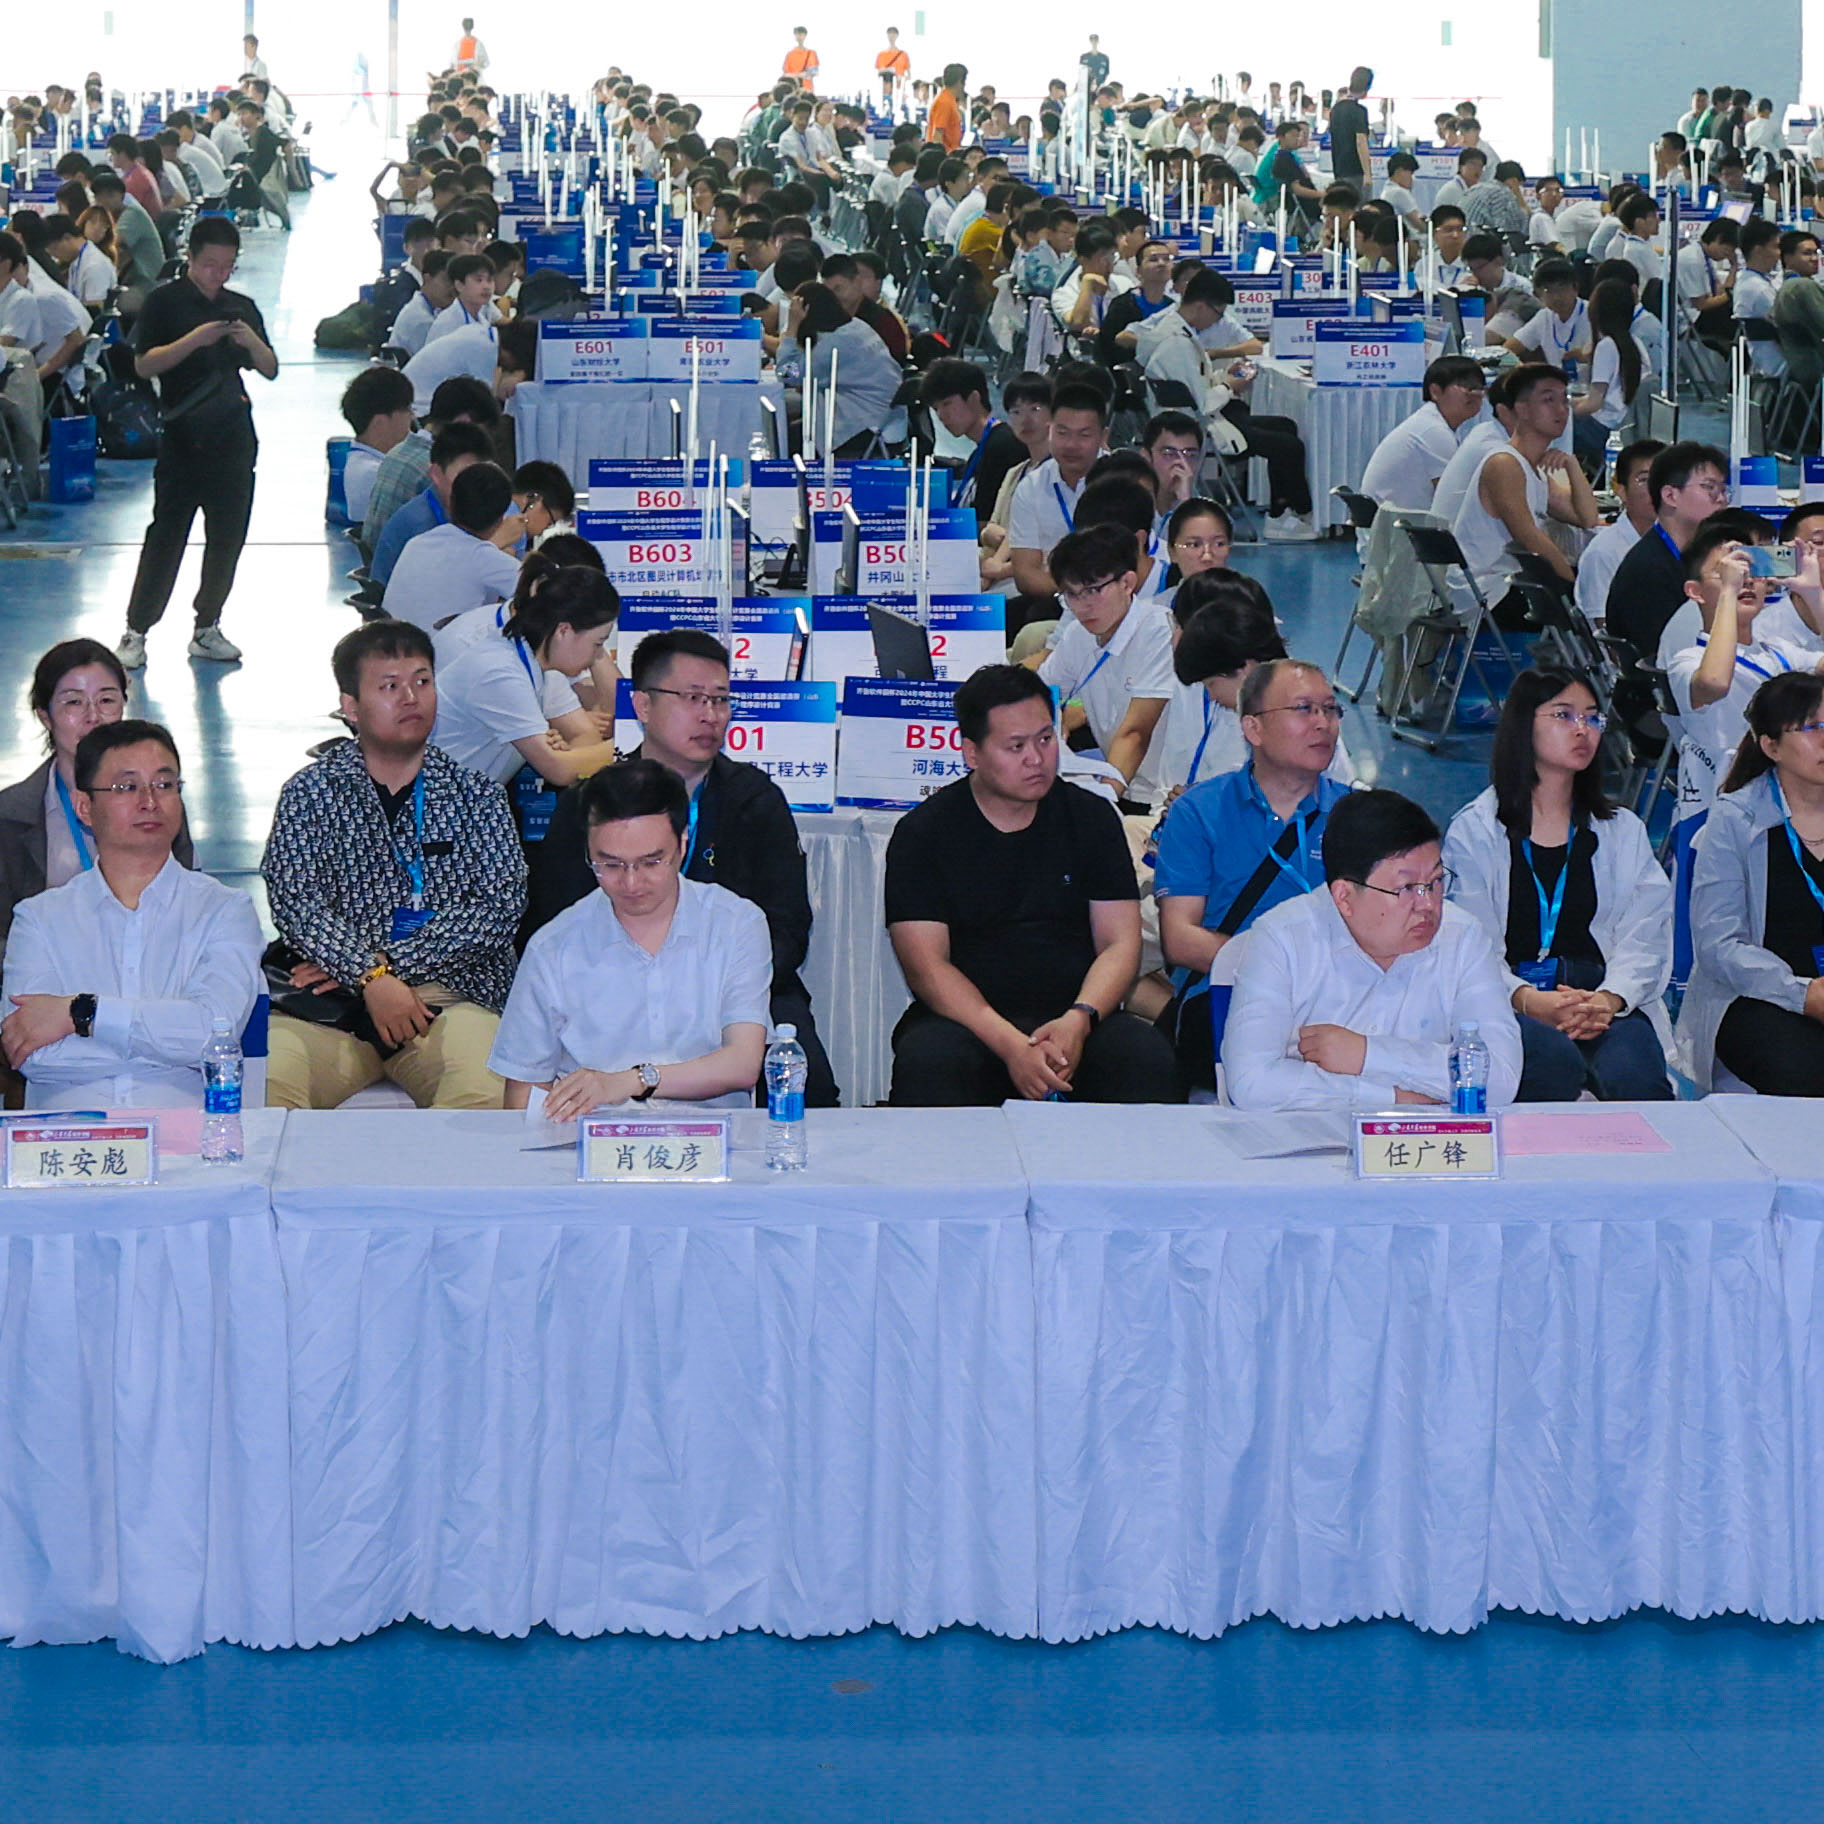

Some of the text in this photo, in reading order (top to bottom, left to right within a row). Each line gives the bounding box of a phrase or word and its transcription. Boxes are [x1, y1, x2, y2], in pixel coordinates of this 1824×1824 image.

[1238, 292, 1273, 304] E403
[575, 341, 614, 354] E601
[1350, 344, 1390, 358] E401
[628, 544, 693, 564] B603
[905, 724, 964, 751] B50
[38, 1149, 130, 1178] 陈安彪
[615, 1142, 704, 1173] 肖俊彦
[1383, 1140, 1469, 1169] 任广锋
